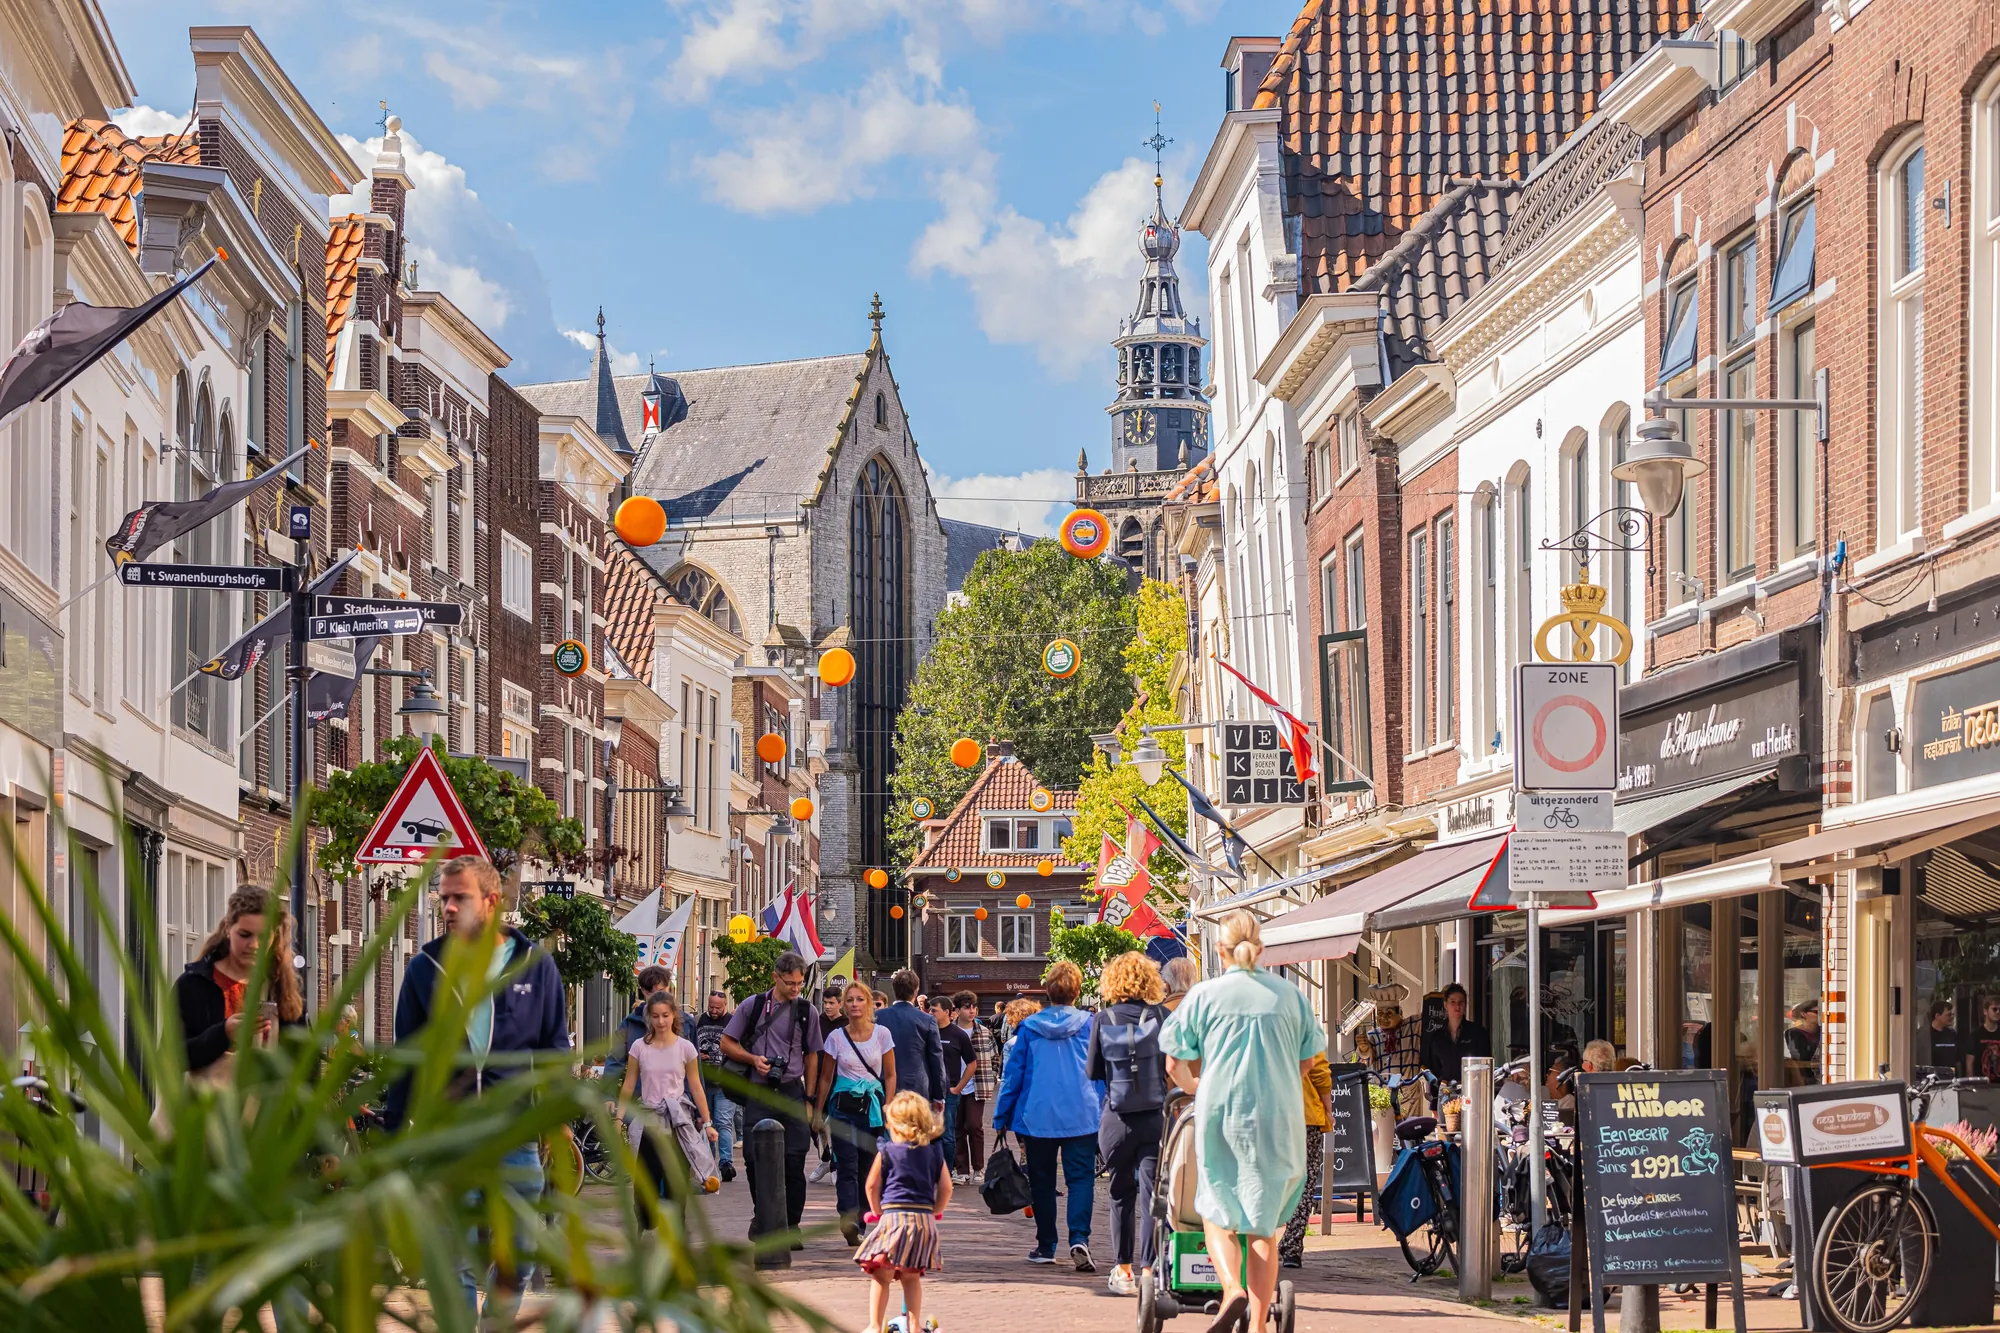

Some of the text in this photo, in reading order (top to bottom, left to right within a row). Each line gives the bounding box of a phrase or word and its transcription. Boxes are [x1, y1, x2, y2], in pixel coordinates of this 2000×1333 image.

[148, 571, 266, 586] 't Swanenburghshofje
[329, 617, 351, 634] Klein
[352, 618, 389, 632] Amerika
[1548, 671, 1589, 684] ZONE
[1660, 721, 1673, 759] de
[1752, 722, 1792, 759] van Herfst
[1252, 752, 1278, 760] VERKAAIK
[1618, 763, 1651, 791] inds 1922
[1530, 795, 1599, 807] uitgezonderd
[1617, 1082, 1660, 1102] NEW
[1611, 1097, 1706, 1119] TANDOOR
[1836, 1108, 1871, 1123] tandoor
[1599, 1125, 1628, 1144] Een
[1630, 1154, 1685, 1180] 1991
[1602, 1259, 1659, 1273] 0182-529733
